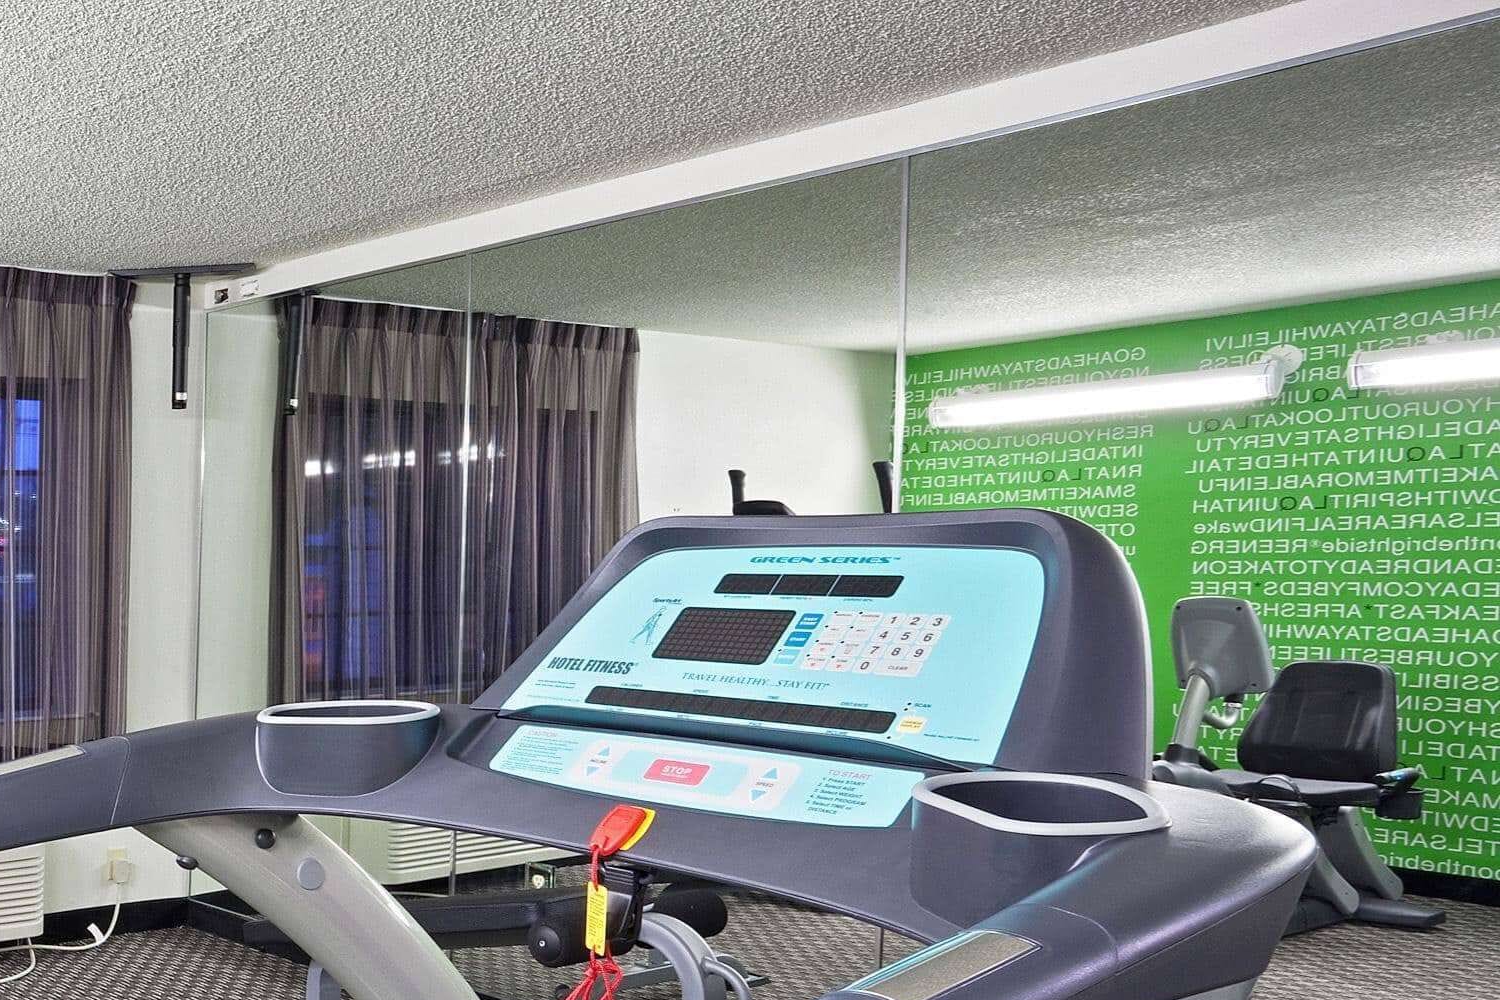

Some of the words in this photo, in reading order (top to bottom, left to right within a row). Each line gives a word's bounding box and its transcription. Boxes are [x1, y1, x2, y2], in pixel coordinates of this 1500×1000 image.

[749, 556, 816, 564] GREEN
[890, 616, 898, 625] 1
[910, 617, 921, 626] 2
[932, 618, 943, 627] 3
[879, 631, 889, 640] 4
[901, 632, 911, 641] 5
[923, 633, 934, 642] 6
[870, 646, 880, 655] 7
[891, 647, 901, 656] 8
[913, 648, 924, 658] 9
[548, 657, 585, 671] HOTEL
[662, 764, 693, 776] STOP
